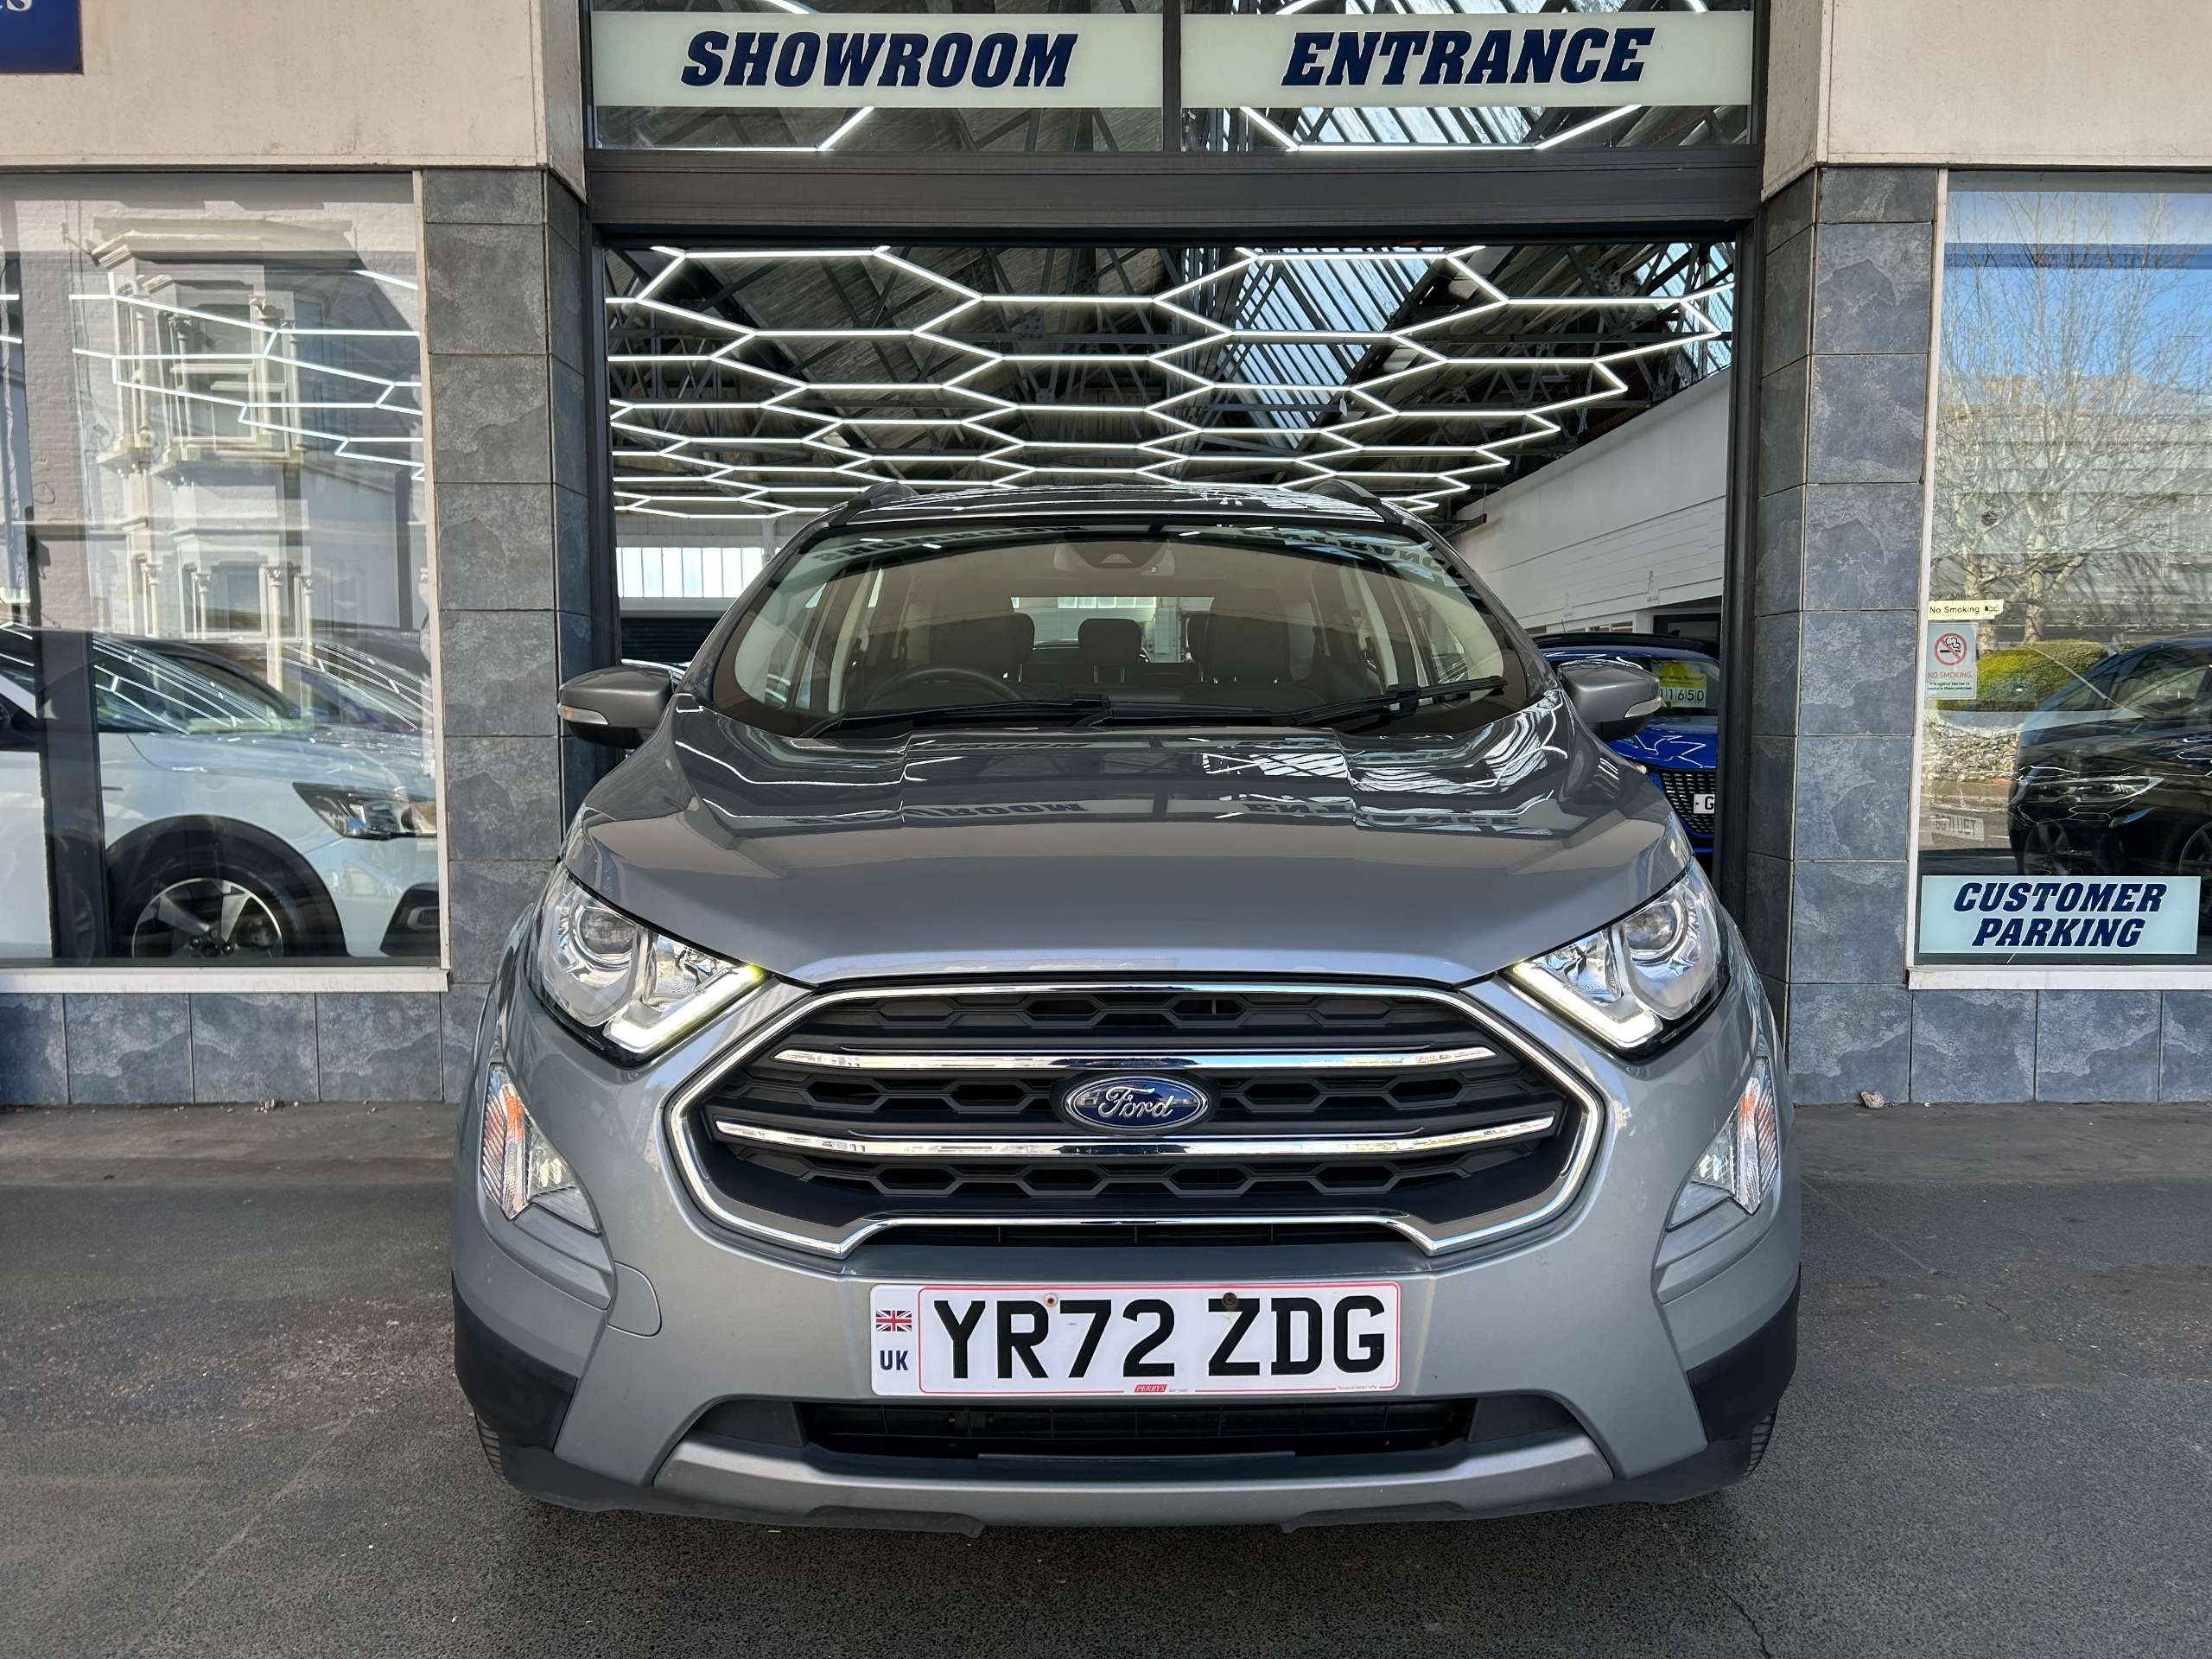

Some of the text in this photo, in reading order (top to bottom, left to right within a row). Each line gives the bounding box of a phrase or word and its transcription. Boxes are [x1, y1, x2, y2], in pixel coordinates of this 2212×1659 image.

[681, 30, 1079, 88] SHOWROOM
[1281, 27, 1656, 86] ENTRANCE
[1929, 606, 1980, 614] No Smoking
[1953, 882, 2167, 912] CUSTOMER
[1971, 918, 2145, 948] PARKING
[1098, 1085, 1175, 1118] Ford
[933, 1294, 1385, 1379] YR72 ZDG
[880, 1350, 909, 1371] UK
[1135, 1384, 1166, 1393] PERRYS
